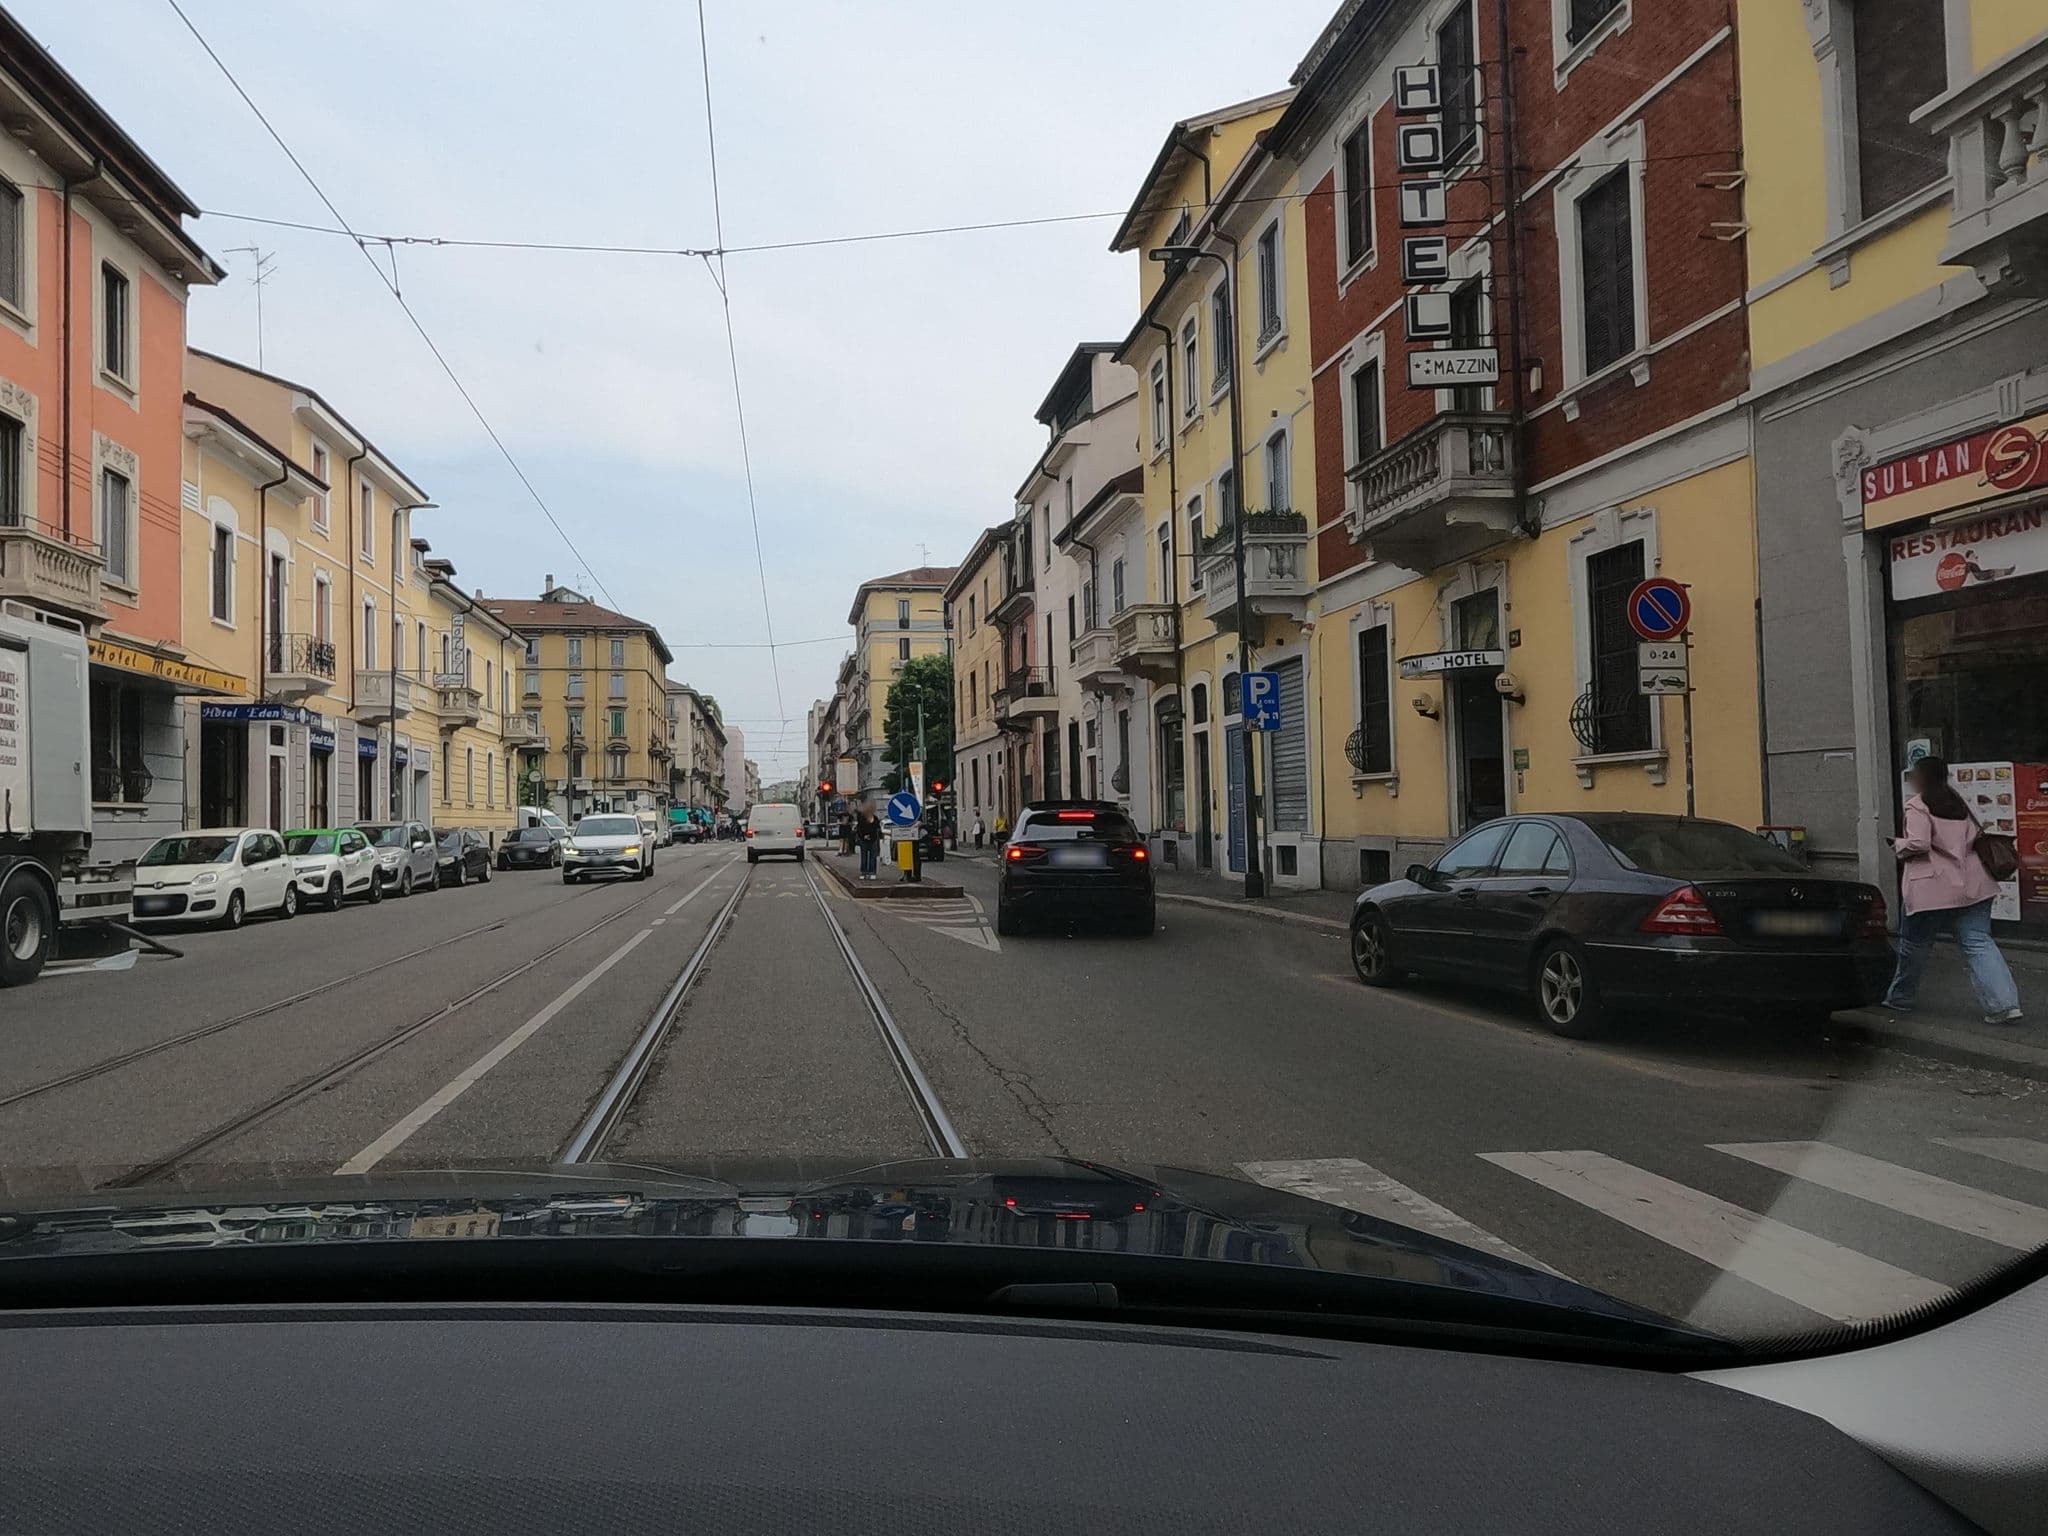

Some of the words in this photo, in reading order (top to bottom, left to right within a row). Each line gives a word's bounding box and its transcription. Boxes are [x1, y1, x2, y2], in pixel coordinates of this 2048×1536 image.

[1400, 68, 1450, 334] HOTEL
[1433, 356, 1496, 375] MAZZINI
[1865, 441, 1970, 499] SULTAN
[1892, 507, 2047, 562] RESTAURAN
[97, 644, 137, 668] Hotel
[152, 657, 208, 685] Mondial
[1443, 653, 1489, 668] HOTEL
[1649, 650, 1677, 660] 0-24
[1250, 676, 1271, 704] P
[201, 706, 238, 718] Hotel
[246, 707, 280, 719] Eden
